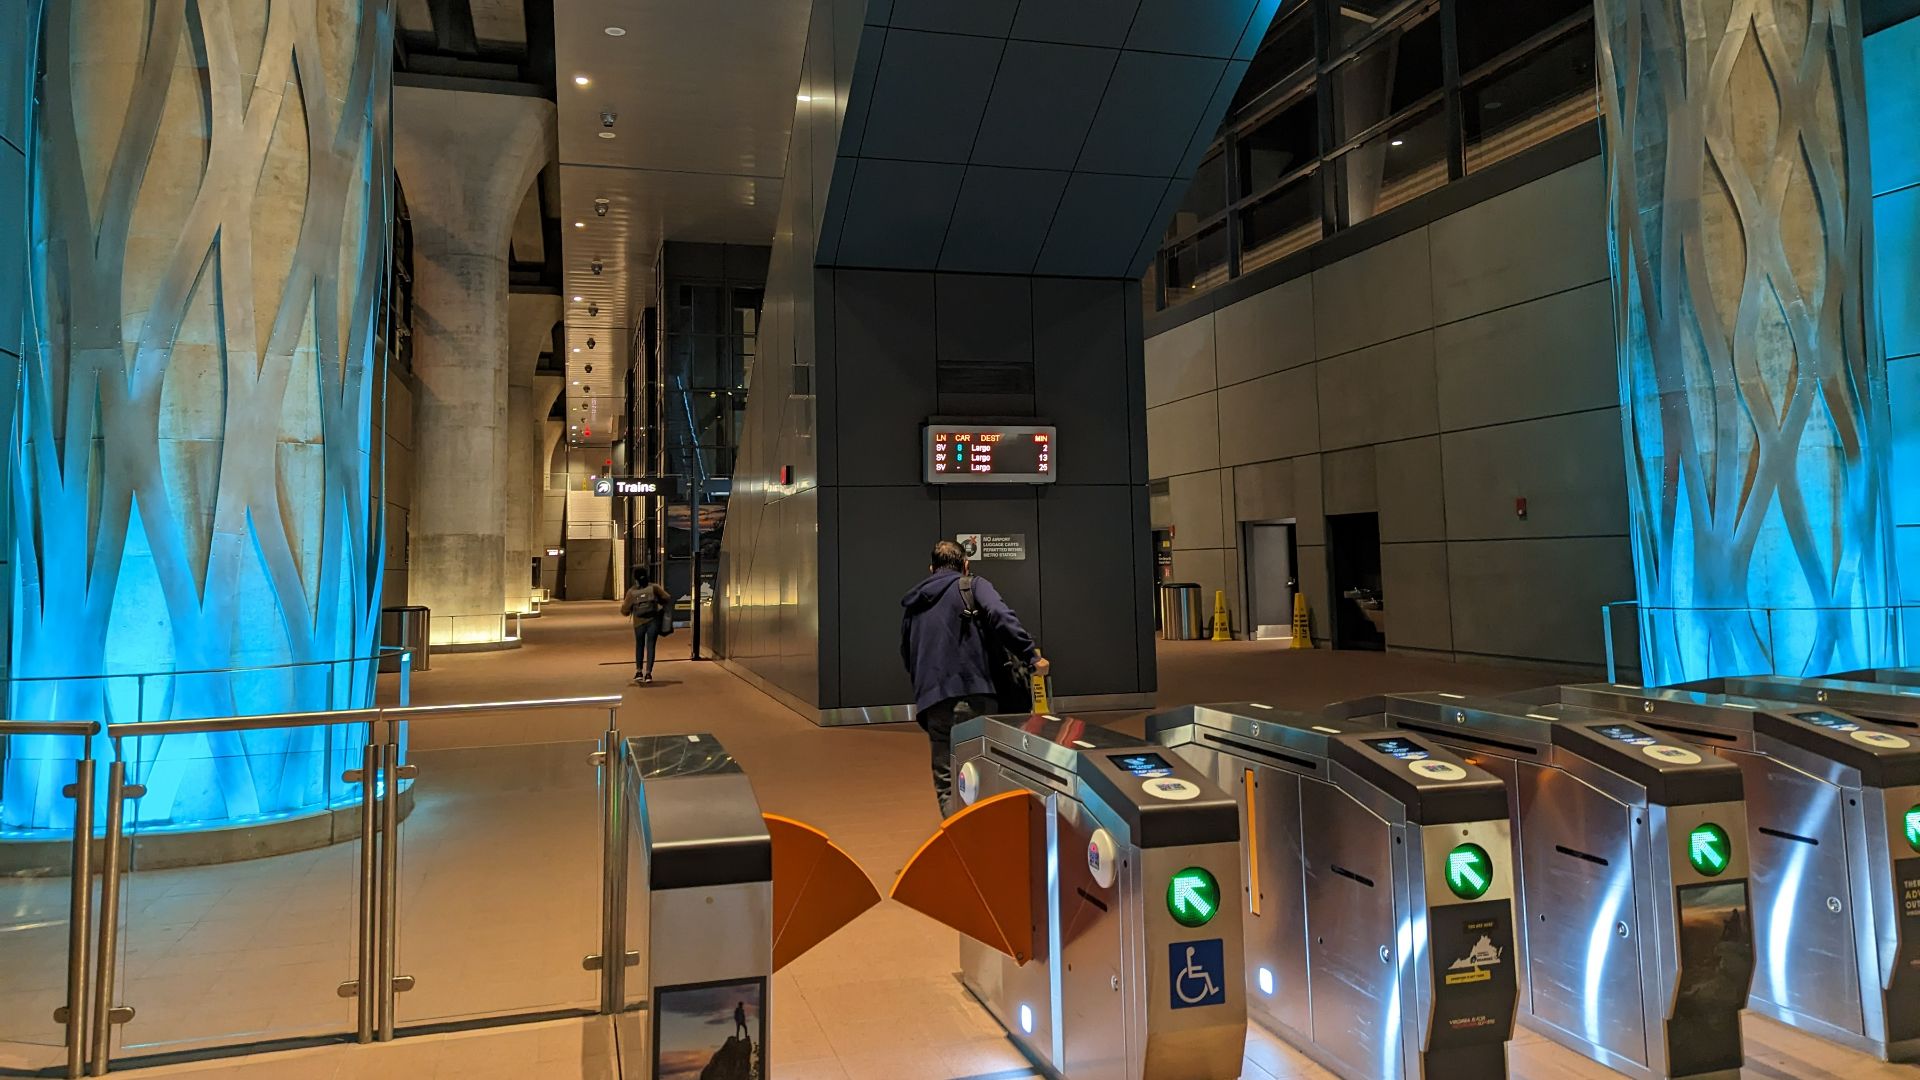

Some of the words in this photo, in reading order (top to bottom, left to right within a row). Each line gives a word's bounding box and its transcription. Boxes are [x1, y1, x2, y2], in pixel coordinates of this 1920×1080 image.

[936, 434, 947, 442] LN
[955, 434, 971, 442] CAR
[980, 434, 1000, 442] DEST
[971, 444, 990, 453] Largo
[971, 454, 990, 462] Largo
[971, 463, 990, 472] Largo
[616, 481, 656, 492] Trains
